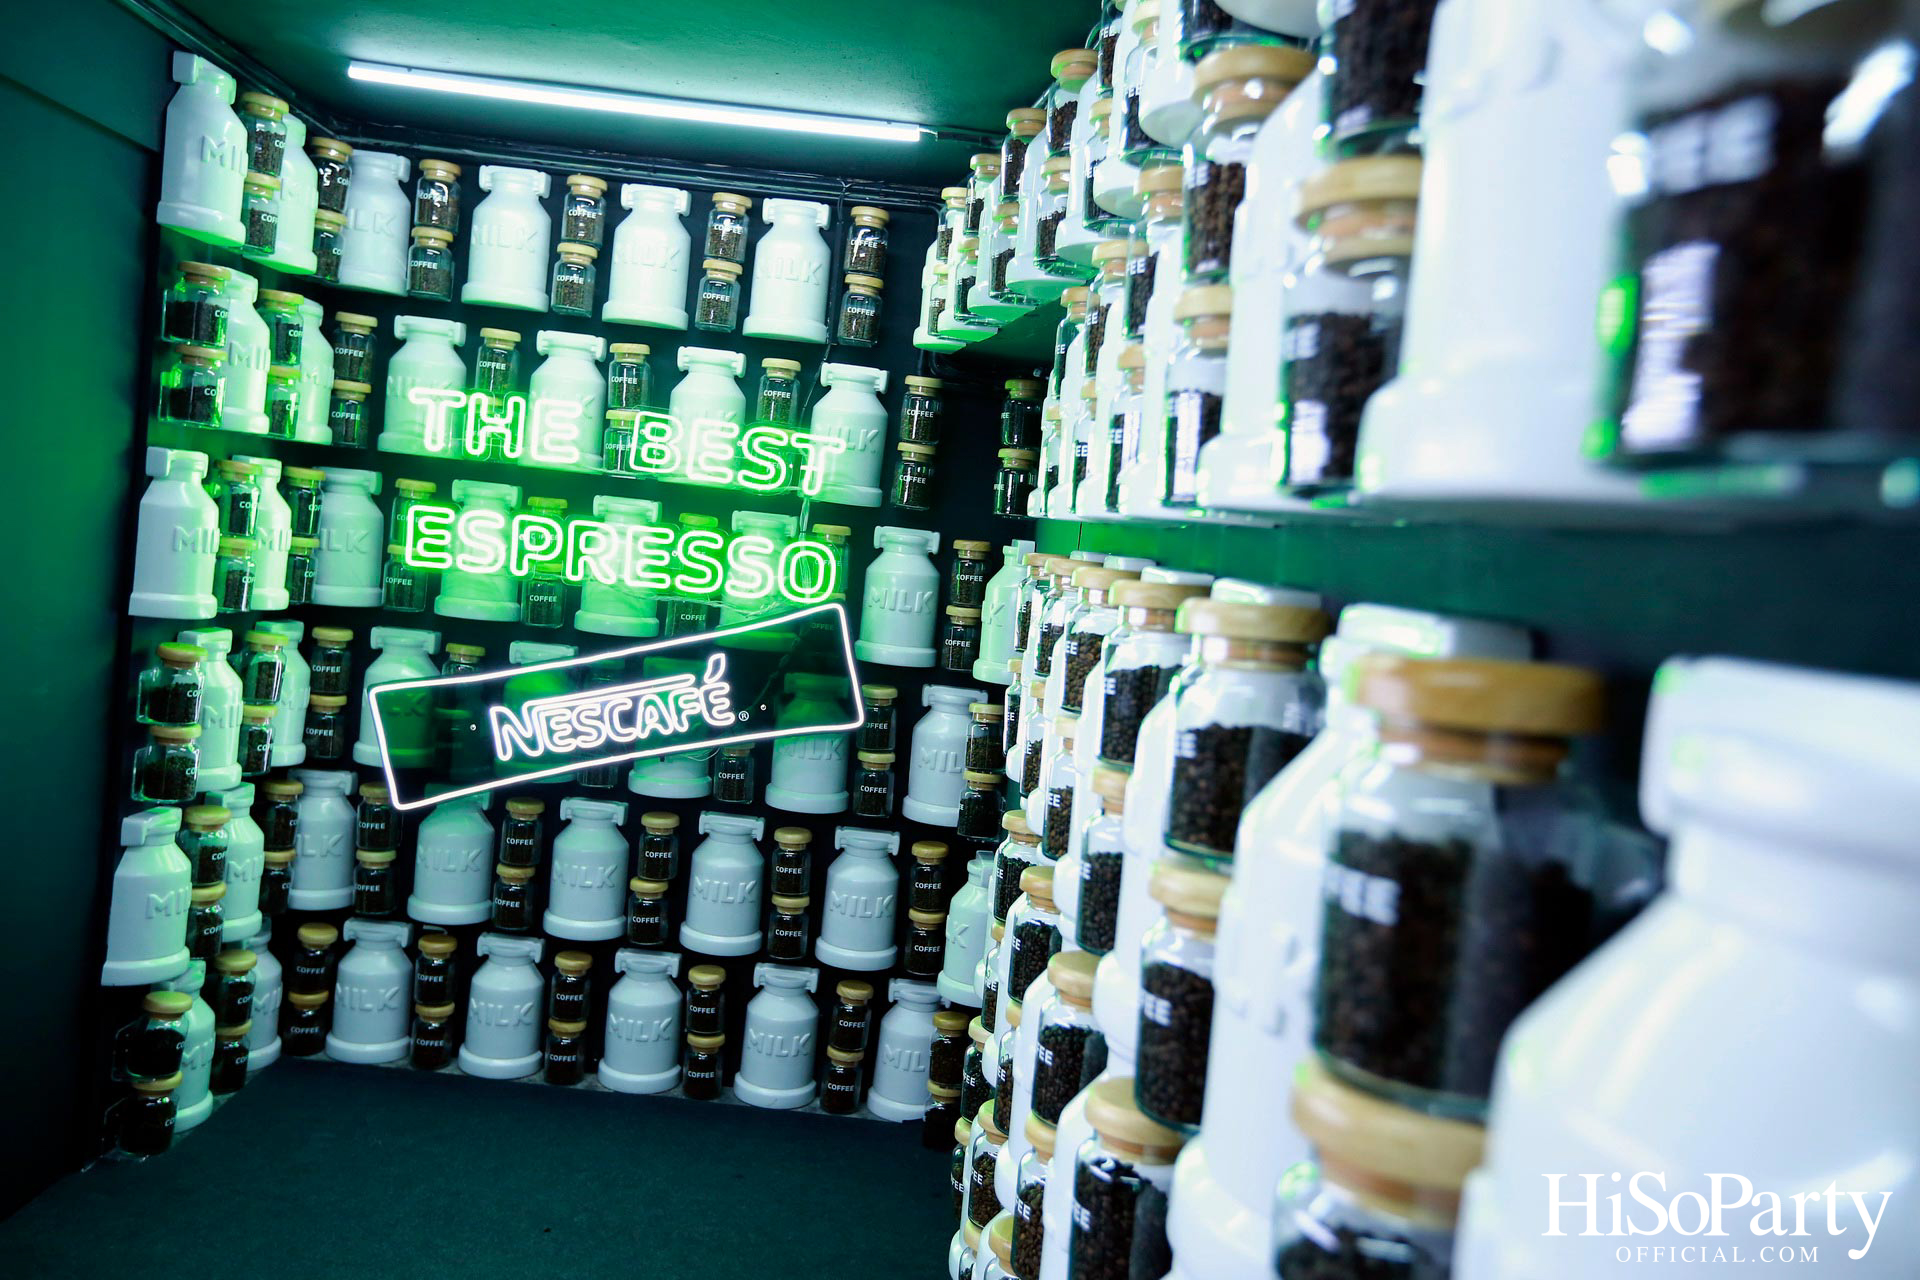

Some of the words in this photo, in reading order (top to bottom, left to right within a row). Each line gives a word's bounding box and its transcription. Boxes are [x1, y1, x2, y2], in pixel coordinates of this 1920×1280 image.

[568, 208, 597, 219] COFFEE
[410, 260, 438, 270] COFFEE
[556, 274, 584, 285] COFFEE
[702, 292, 730, 302] COFFEE
[847, 306, 875, 317] COFFEE
[334, 347, 364, 358] COFFEE
[479, 360, 506, 370] COFFEE
[611, 375, 638, 385] COFFEE
[764, 389, 791, 399] COFFEE
[331, 411, 360, 420] COFFEE
[906, 409, 934, 418] COFFEE
[408, 386, 582, 465] THE
[629, 410, 847, 497] BEST
[899, 475, 926, 484] COFFEE
[319, 527, 369, 553] ILK
[404, 504, 837, 605] ESPRESSO
[386, 576, 413, 585] COFFEE
[957, 574, 983, 582] COFFEE
[529, 594, 557, 603] COFFEE
[868, 586, 934, 615] MILK
[681, 613, 706, 621] COFFEE
[945, 639, 971, 648] COFFEE
[312, 664, 341, 673] COFFEE
[305, 728, 334, 737] COFFEE
[919, 750, 962, 774] MIL
[718, 772, 745, 780] COFFEE
[860, 785, 887, 794] COFFEE
[358, 821, 385, 830] COFFEE
[506, 837, 533, 846] COFFEE
[645, 850, 672, 859] COFFEE
[553, 860, 617, 888] MILK
[775, 866, 802, 874] COFFEE
[353, 883, 380, 892] COFFEE
[693, 875, 756, 904] MILK
[915, 881, 942, 890] COFFEE
[494, 897, 520, 908] COFFEE
[830, 891, 893, 919] MILK
[632, 916, 660, 924] COFFEE
[775, 929, 802, 937] COFFEE
[914, 944, 940, 953] COFFEE
[296, 966, 325, 974] COFFEE
[417, 974, 443, 982] COFFEE
[556, 993, 583, 1001] COFFEE
[470, 997, 533, 1027] MILK
[689, 1005, 716, 1014] COFFEE
[609, 1013, 672, 1042] MILK
[839, 1019, 865, 1028] COFFEE
[290, 1026, 319, 1034] COFFEE
[417, 1039, 444, 1047] COFFEE
[748, 1028, 811, 1058] MILK
[550, 1054, 576, 1062] COFFEE
[882, 1043, 926, 1072] MIL
[687, 1071, 714, 1079] COFFEE
[827, 1082, 854, 1091] COFFEE
